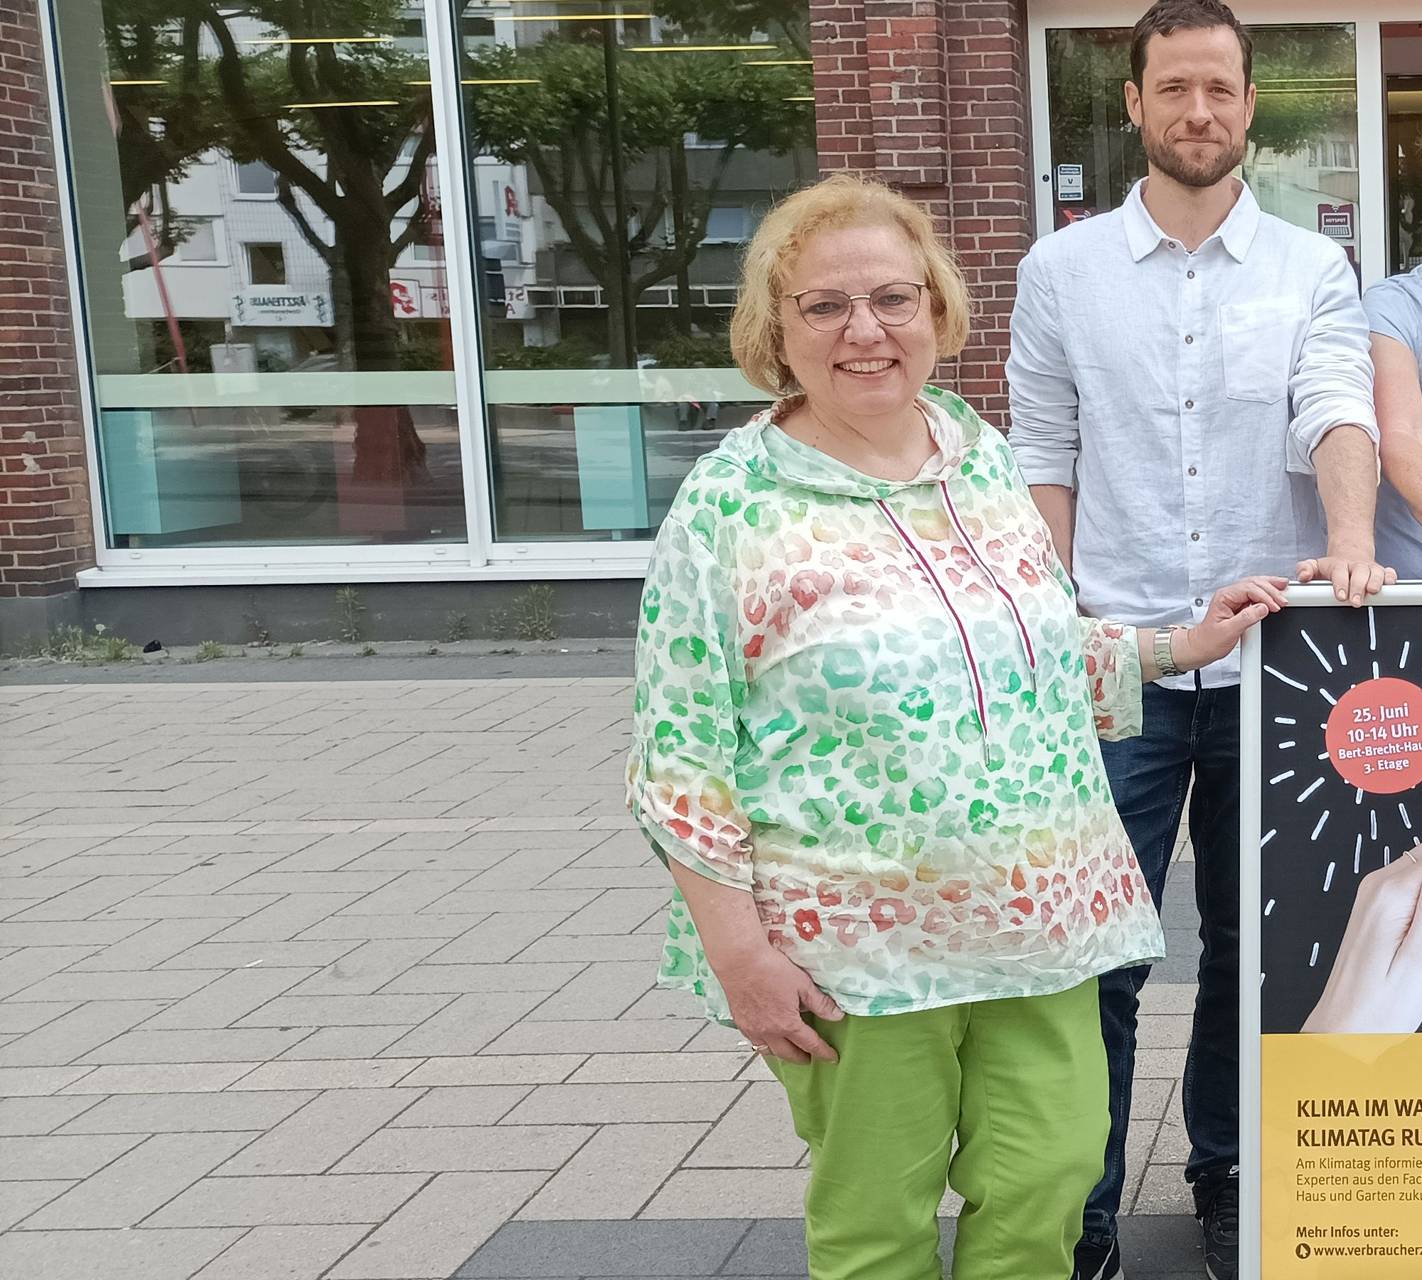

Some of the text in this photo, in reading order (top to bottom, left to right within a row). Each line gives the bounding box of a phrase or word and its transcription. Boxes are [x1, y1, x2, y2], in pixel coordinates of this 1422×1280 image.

[1353, 702, 1408, 722] 25. Juni
[1347, 723, 1418, 742] 10-14 Uhr
[1364, 758, 1409, 774] 3. Etage
[1297, 1099, 1359, 1117] KLIMA
[1365, 1099, 1389, 1117] IM
[1297, 1129, 1395, 1146] KLIMATAG
[1296, 1158, 1315, 1169] Am
[1319, 1157, 1371, 1171] Klimatag
[1296, 1174, 1349, 1188] Experten
[1353, 1176, 1374, 1185] aus
[1377, 1173, 1399, 1185] den
[1296, 1190, 1326, 1201] Haus
[1330, 1190, 1352, 1201] und
[1356, 1190, 1395, 1201] Garten
[1296, 1226, 1399, 1237] Mehr Infos unter:
